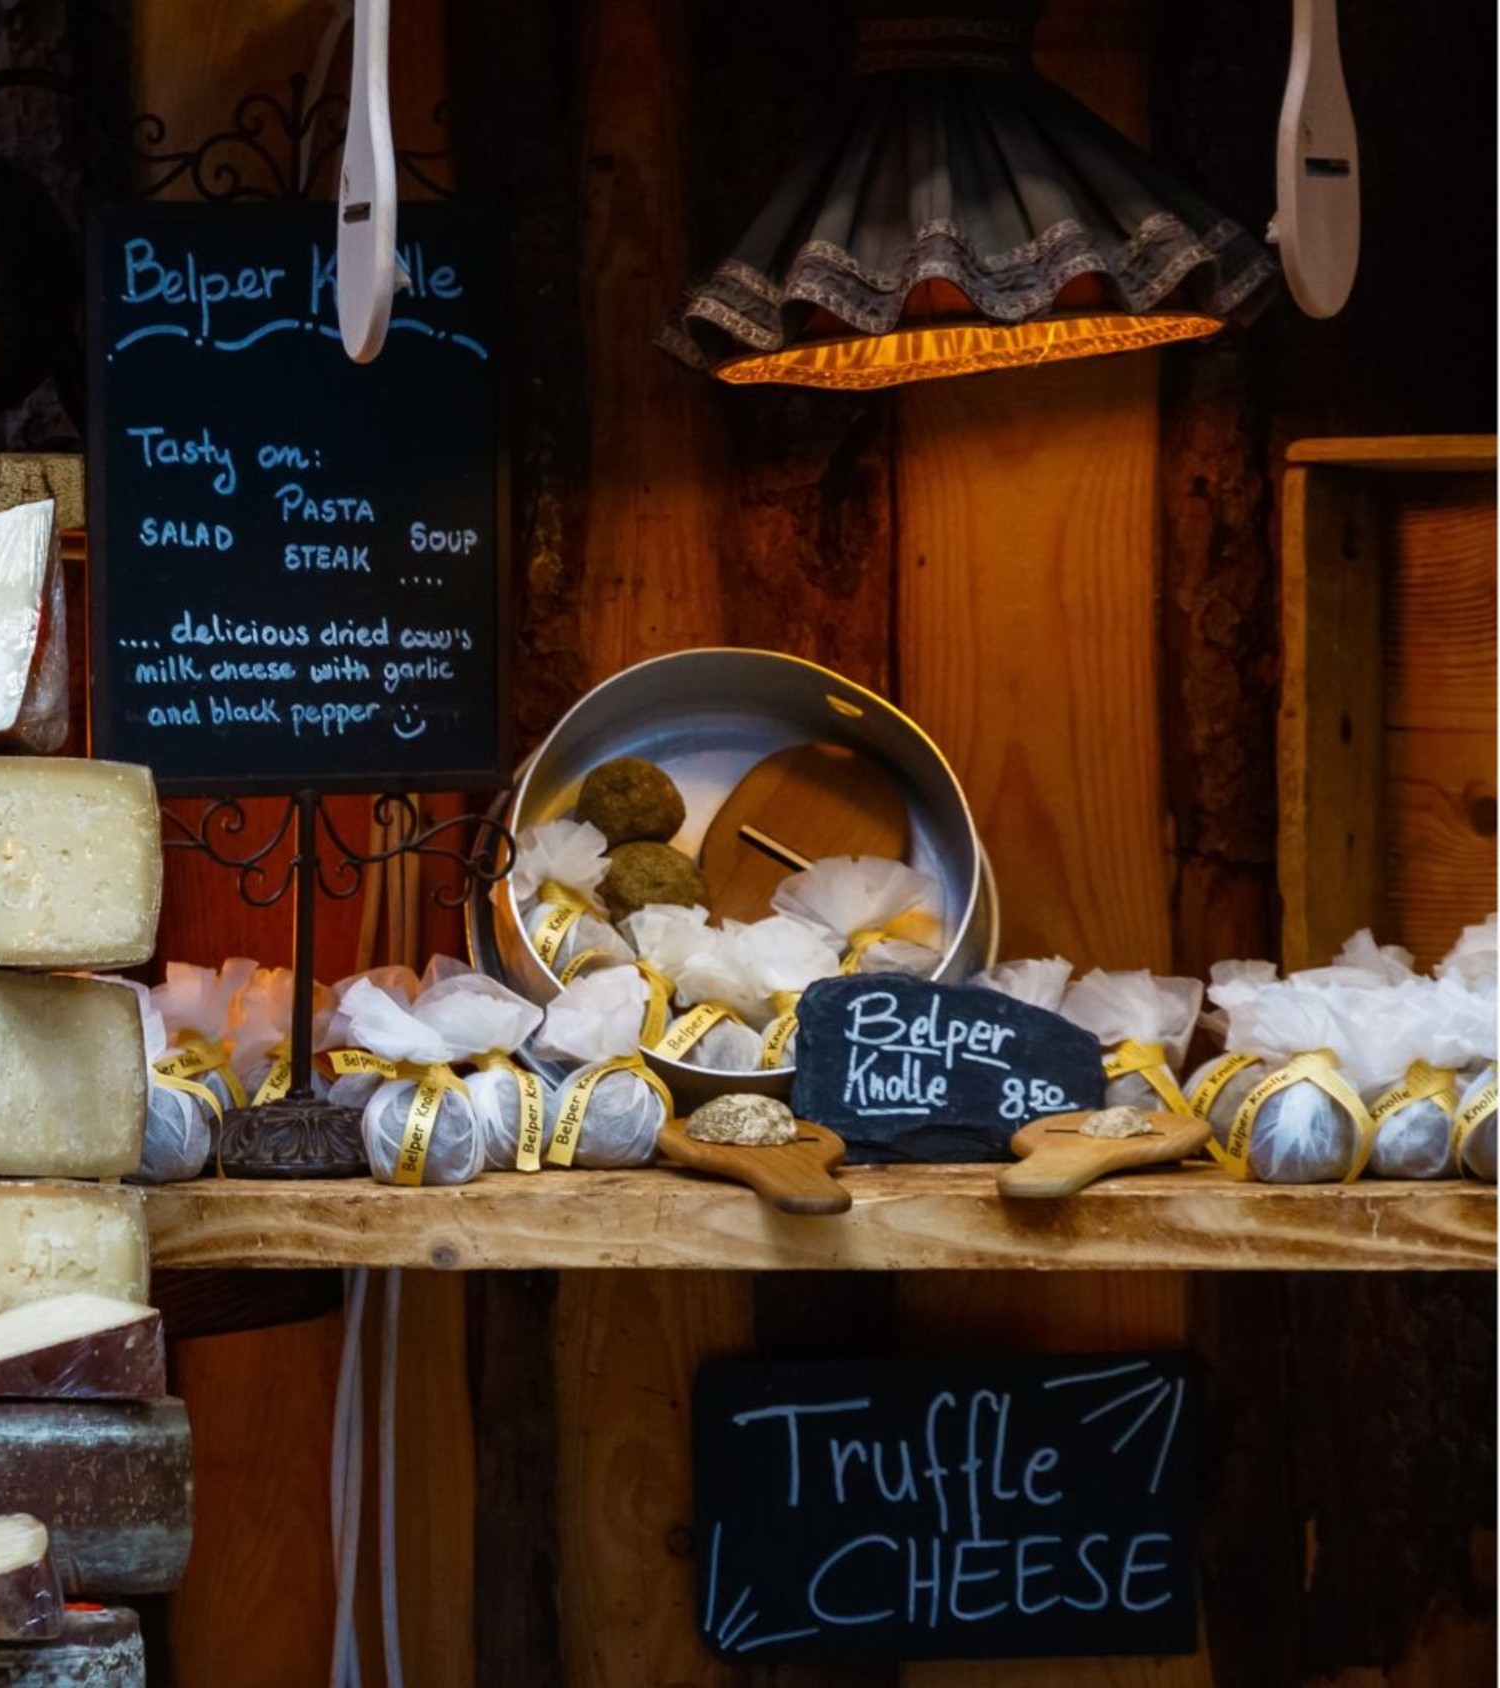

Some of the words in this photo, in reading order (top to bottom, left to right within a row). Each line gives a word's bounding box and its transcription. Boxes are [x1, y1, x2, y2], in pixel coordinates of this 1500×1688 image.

[122, 238, 285, 337] Belper
[311, 242, 464, 315] Klle
[128, 427, 236, 495] Tasty
[258, 445, 321, 469] on:
[276, 484, 375, 523] PASTA
[140, 518, 233, 551] SALAD
[284, 544, 371, 573] STEAK
[171, 610, 310, 647] delicious
[320, 617, 389, 648] dried
[135, 654, 203, 684] milk
[210, 660, 296, 682] cheese
[310, 655, 370, 684] with
[384, 658, 454, 693] garlic
[147, 700, 200, 727] and
[209, 696, 281, 725] black
[290, 703, 381, 737] pepper
[667, 1014, 705, 1051] Belper
[845, 992, 1015, 1069] Belper
[844, 1045, 948, 1107] Knolle
[522, 1104, 541, 1154] Belper
[556, 1095, 582, 1145] Belper
[733, 1390, 1062, 1541] Truffle
[808, 1533, 1172, 1628] CHEESE
